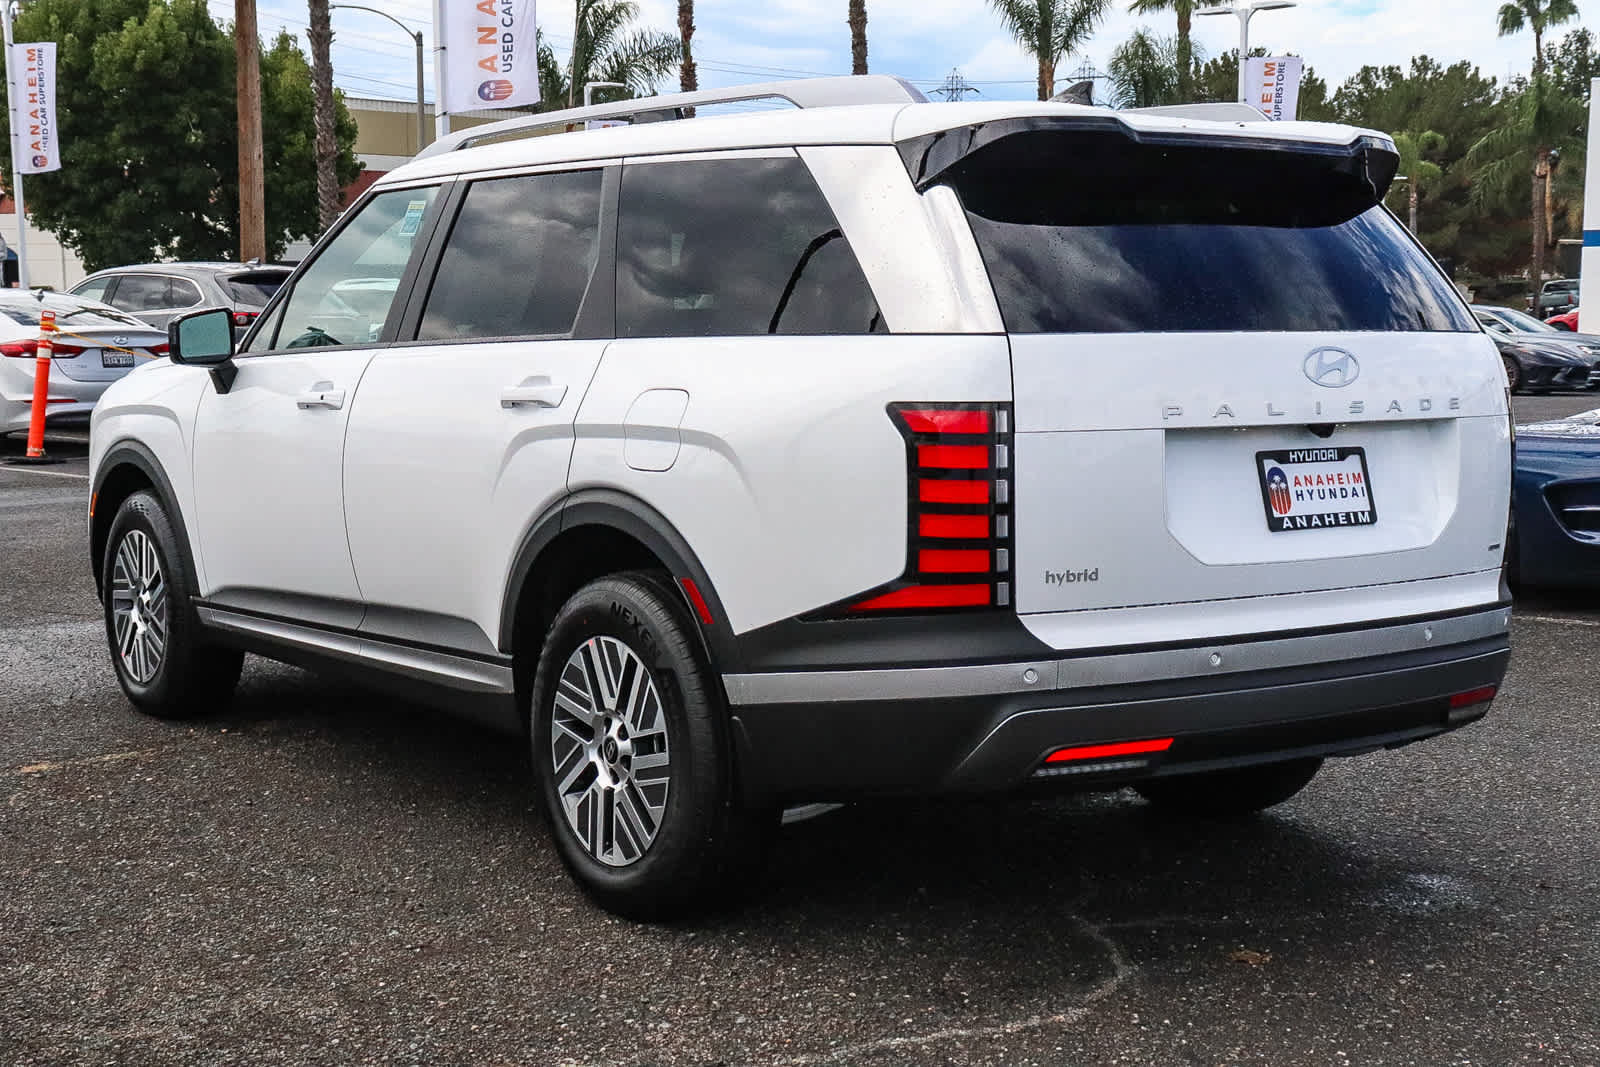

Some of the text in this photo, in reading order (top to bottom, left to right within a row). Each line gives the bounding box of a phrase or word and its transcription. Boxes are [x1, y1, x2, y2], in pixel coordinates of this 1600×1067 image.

[502, 32, 514, 73] USED
[37, 47, 46, 105] SUPERSTORE
[1261, 62, 1276, 114] EIM
[26, 48, 41, 151] ANAHEIM
[40, 107, 48, 126] CAR
[1162, 397, 1461, 420] PALISADE
[1289, 449, 1338, 462] HYUNDAI
[1293, 472, 1363, 487] ANAHEIM
[1295, 486, 1366, 501] HYUNDAI
[1282, 511, 1371, 529] ANAHEIM
[1045, 567, 1099, 587] hybrid
